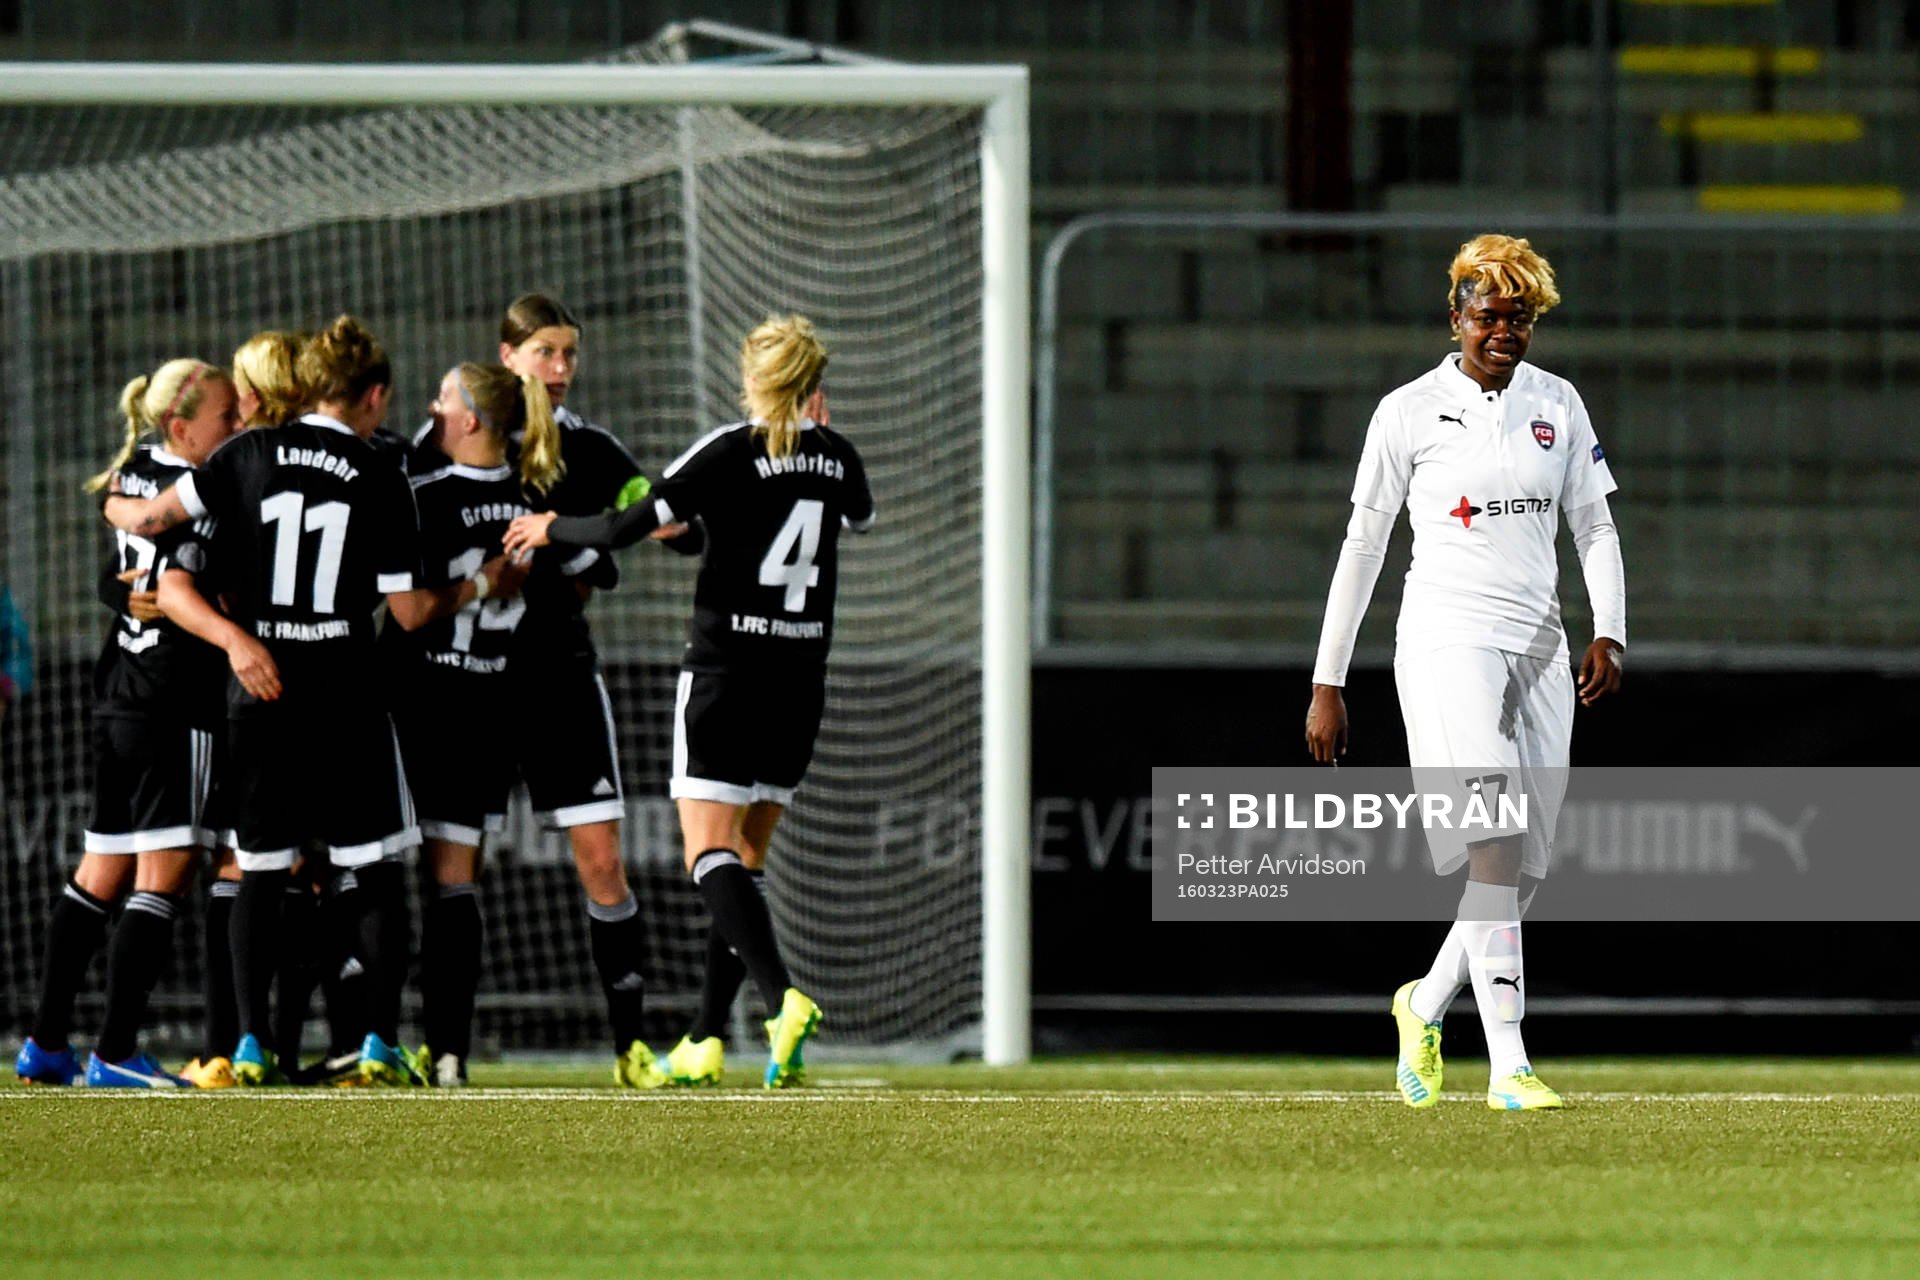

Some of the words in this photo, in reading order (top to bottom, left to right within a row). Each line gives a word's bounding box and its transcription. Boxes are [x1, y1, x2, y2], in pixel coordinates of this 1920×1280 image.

[277, 445, 359, 482] Laudehr
[754, 453, 844, 481] Hendrich
[261, 490, 351, 614] 11
[758, 498, 825, 613] 4
[275, 619, 350, 642] FRANKFURT
